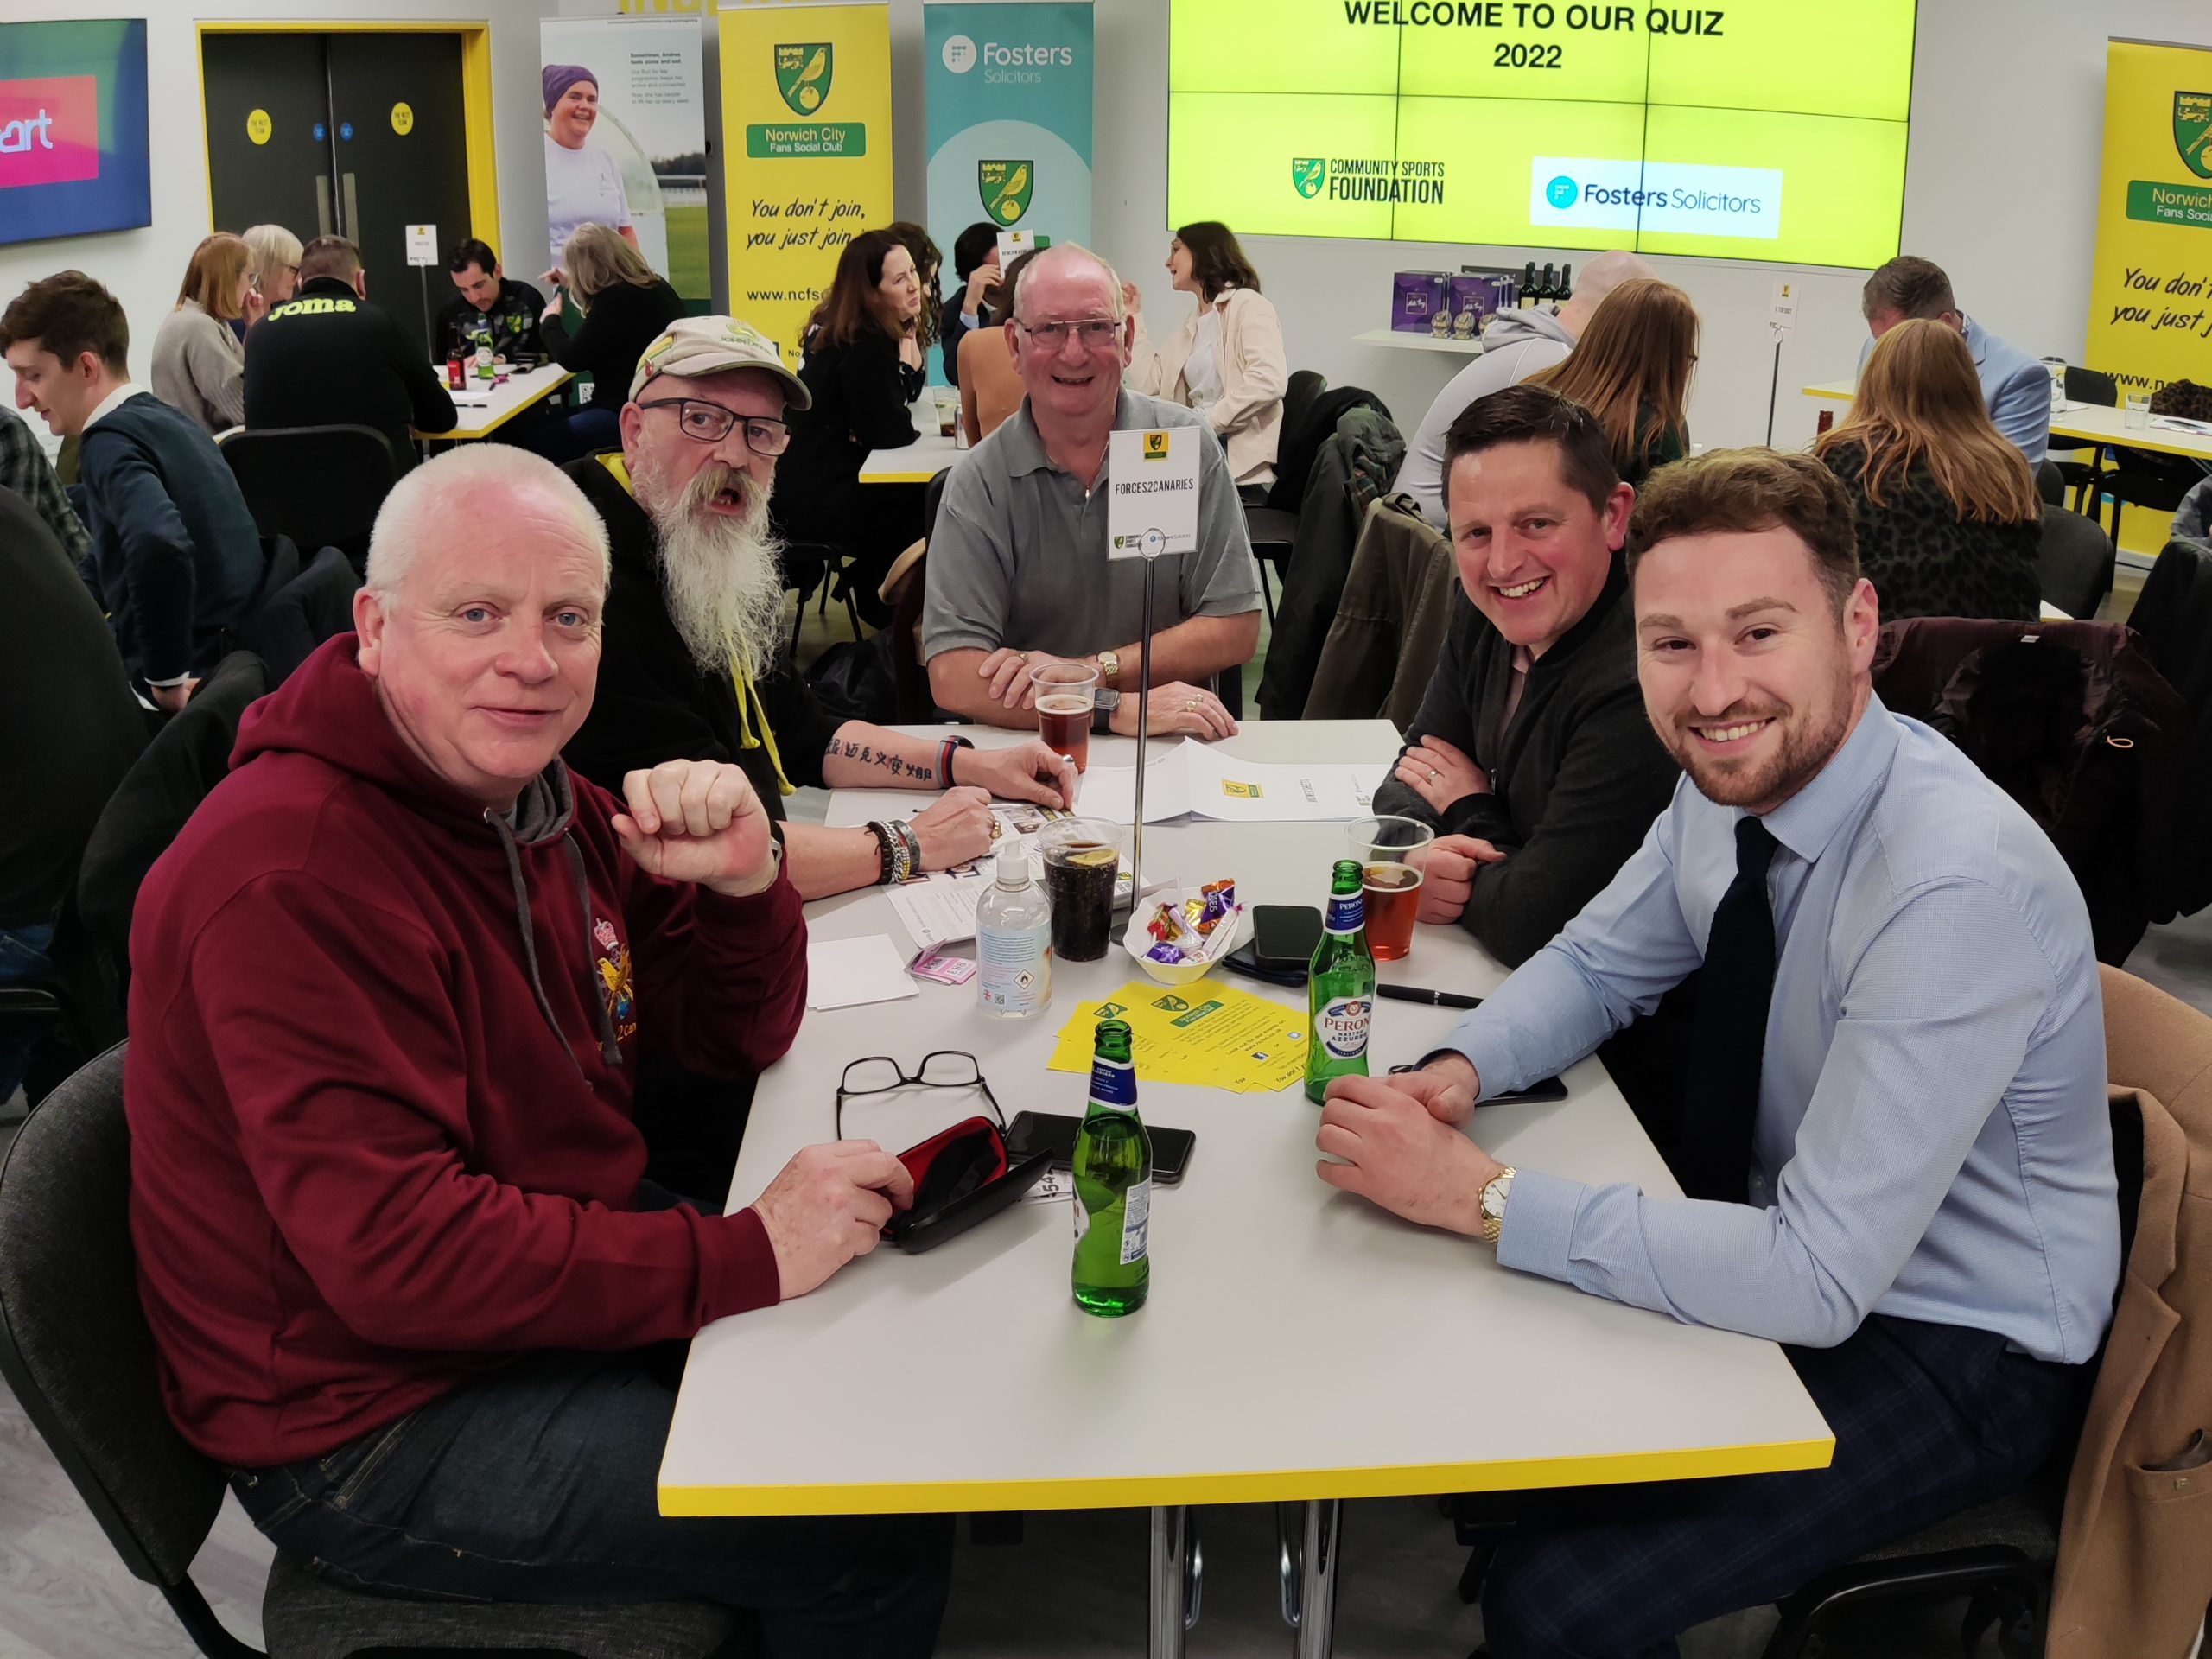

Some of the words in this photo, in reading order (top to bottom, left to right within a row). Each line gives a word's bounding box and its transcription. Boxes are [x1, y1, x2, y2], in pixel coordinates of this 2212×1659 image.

[1344, 0, 1503, 27] WELCOME
[1513, 3, 1555, 29] TO
[1566, 5, 1635, 32] OUR
[1645, 9, 1725, 36] QUIZ
[983, 42, 1073, 66] Fosters
[1493, 43, 1562, 69] 2022
[983, 68, 1042, 84] Solicitors
[0, 108, 53, 153] art
[765, 128, 817, 142] Norwich
[821, 127, 846, 143] City
[770, 143, 791, 153] Fans
[794, 142, 820, 153] Social
[823, 142, 842, 152] Club
[1330, 158, 1398, 176] COMMUNITY
[1402, 161, 1445, 177] SPORTS
[1329, 176, 1445, 204] FOUNDATION
[1584, 184, 1668, 207] Fosters
[1671, 188, 1761, 213] Solicitors
[751, 199, 780, 217] You
[785, 197, 829, 217] don't
[827, 200, 866, 221] join,
[2156, 205, 2183, 219] Fans
[746, 232, 776, 251] you
[778, 226, 820, 250] just
[817, 228, 852, 250] join
[2123, 268, 2160, 292] You
[747, 288, 821, 301] www.ncfs
[2110, 306, 2151, 326] you
[2150, 307, 2205, 331] just
[1115, 478, 1194, 495] FORCES2CANARIES
[1331, 1032, 1368, 1043] AZZURRO
